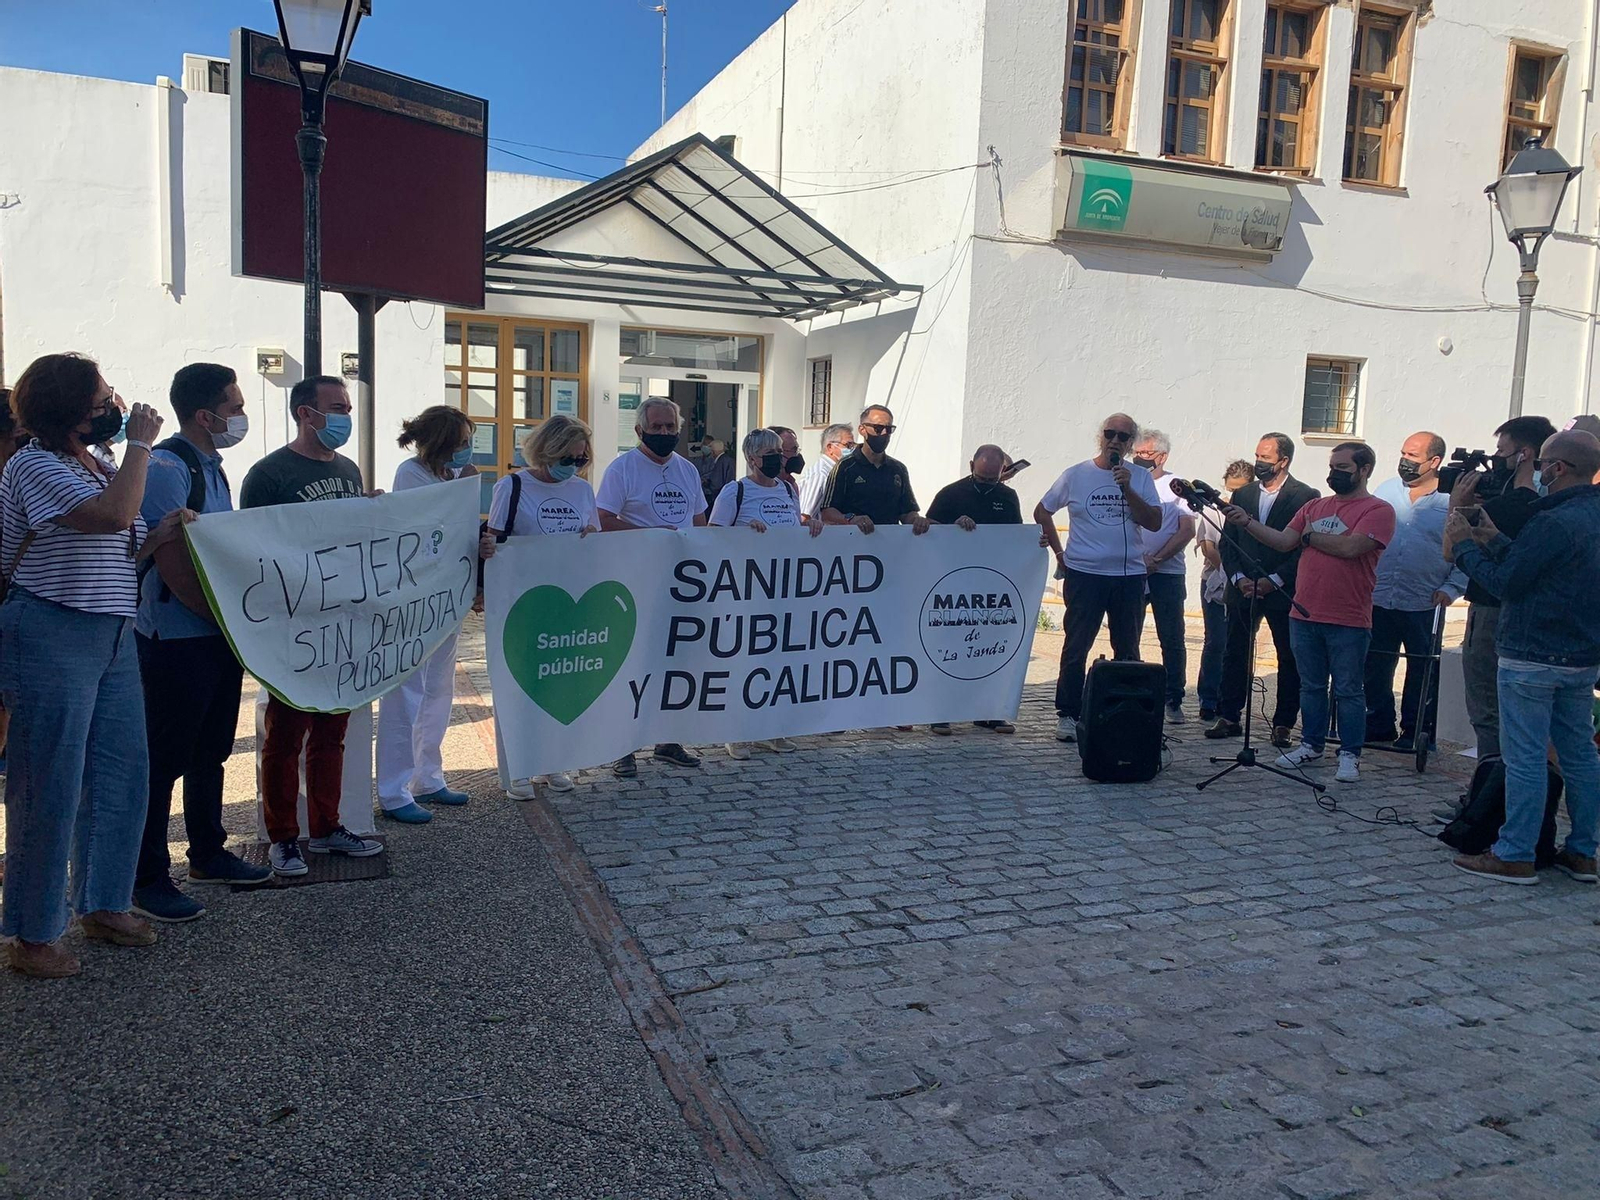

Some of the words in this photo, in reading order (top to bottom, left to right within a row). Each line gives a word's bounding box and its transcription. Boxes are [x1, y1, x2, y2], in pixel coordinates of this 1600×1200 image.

[1197, 202, 1233, 221] Centro
[1236, 207, 1249, 222] de
[1252, 208, 1280, 227] Salud
[1212, 222, 1230, 237] Vejer
[297, 477, 344, 502] LONDON
[670, 554, 885, 603] SANIDAD
[933, 593, 1013, 610] MAREA
[928, 608, 1018, 627] BLANCA
[293, 617, 353, 673] SIN
[537, 626, 609, 650] Sanidad
[665, 606, 883, 659] PÚBLICA
[964, 628, 981, 642] de
[538, 655, 604, 680] pública
[628, 673, 652, 720] Y
[660, 670, 730, 712] DE
[742, 656, 918, 710] CALIDAD
